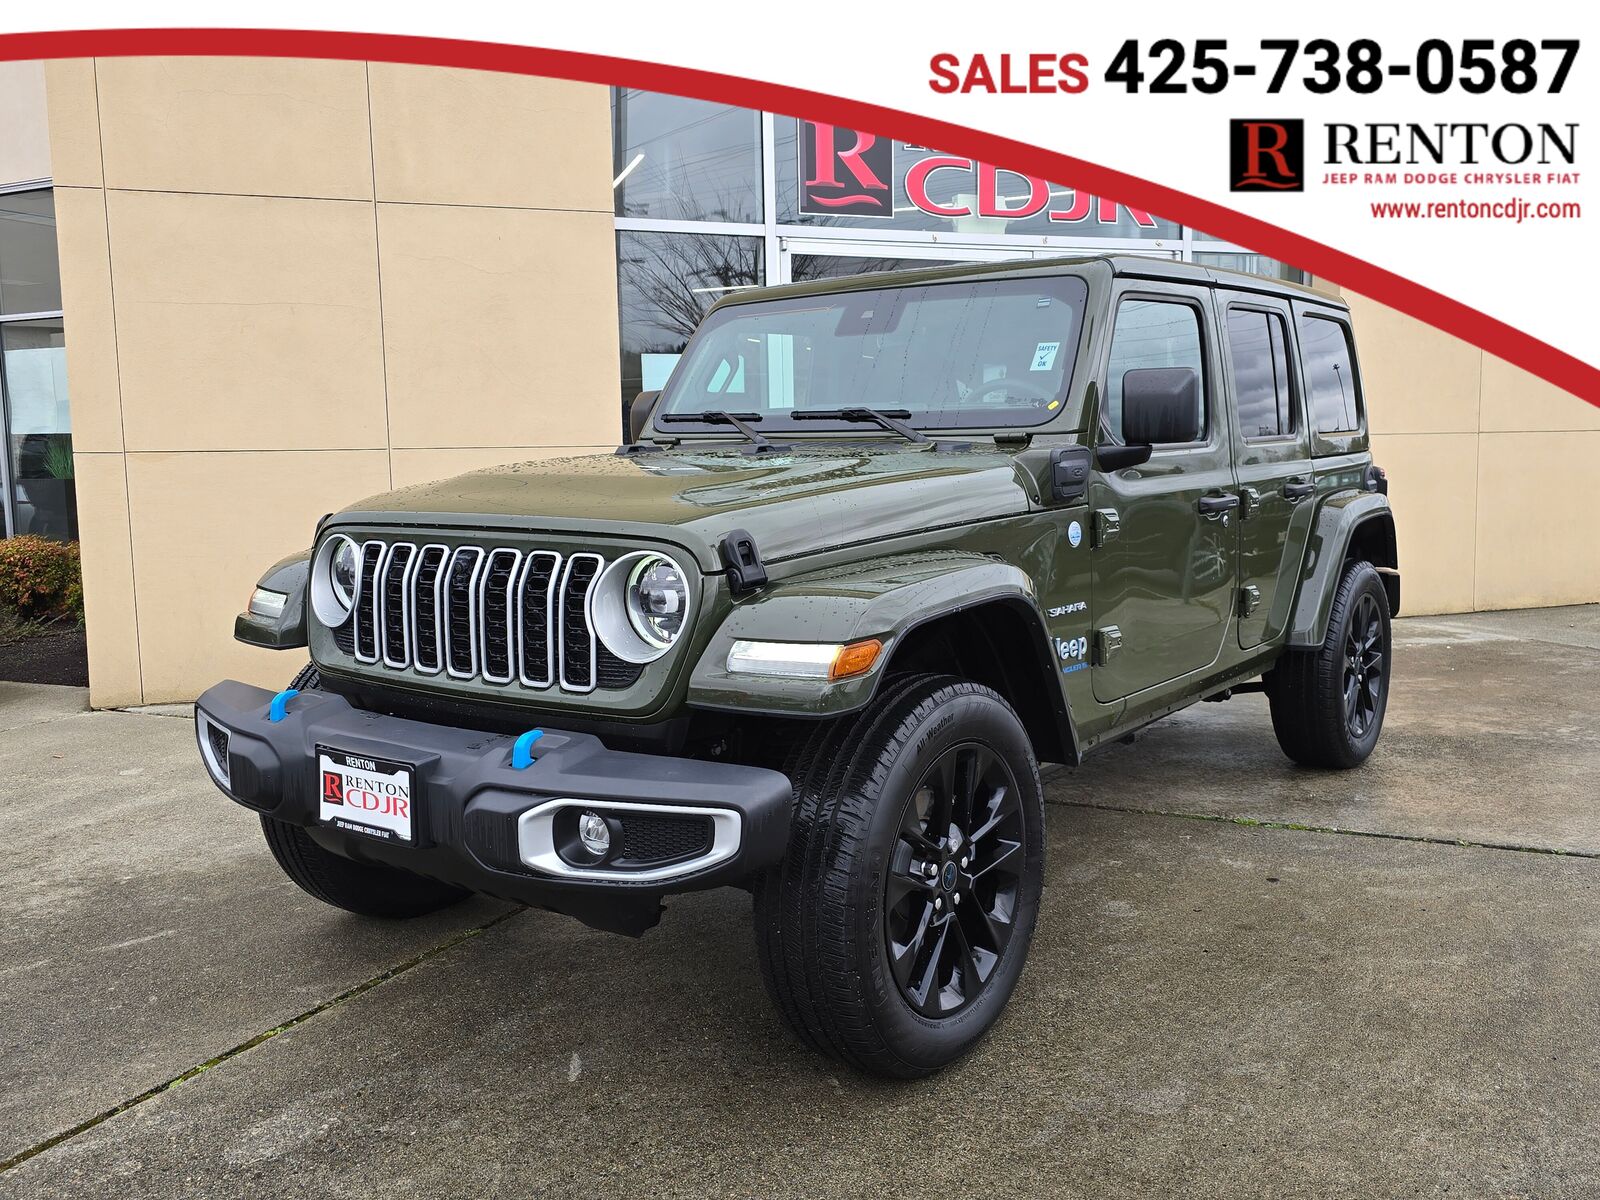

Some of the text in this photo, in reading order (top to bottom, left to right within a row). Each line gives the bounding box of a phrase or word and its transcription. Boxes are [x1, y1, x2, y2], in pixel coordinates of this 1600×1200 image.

[1049, 601, 1087, 617] SAHARA
[345, 756, 376, 771] RENTON
[324, 773, 342, 798] R
[345, 775, 409, 799] RENTON
[346, 788, 408, 818] CDJR
